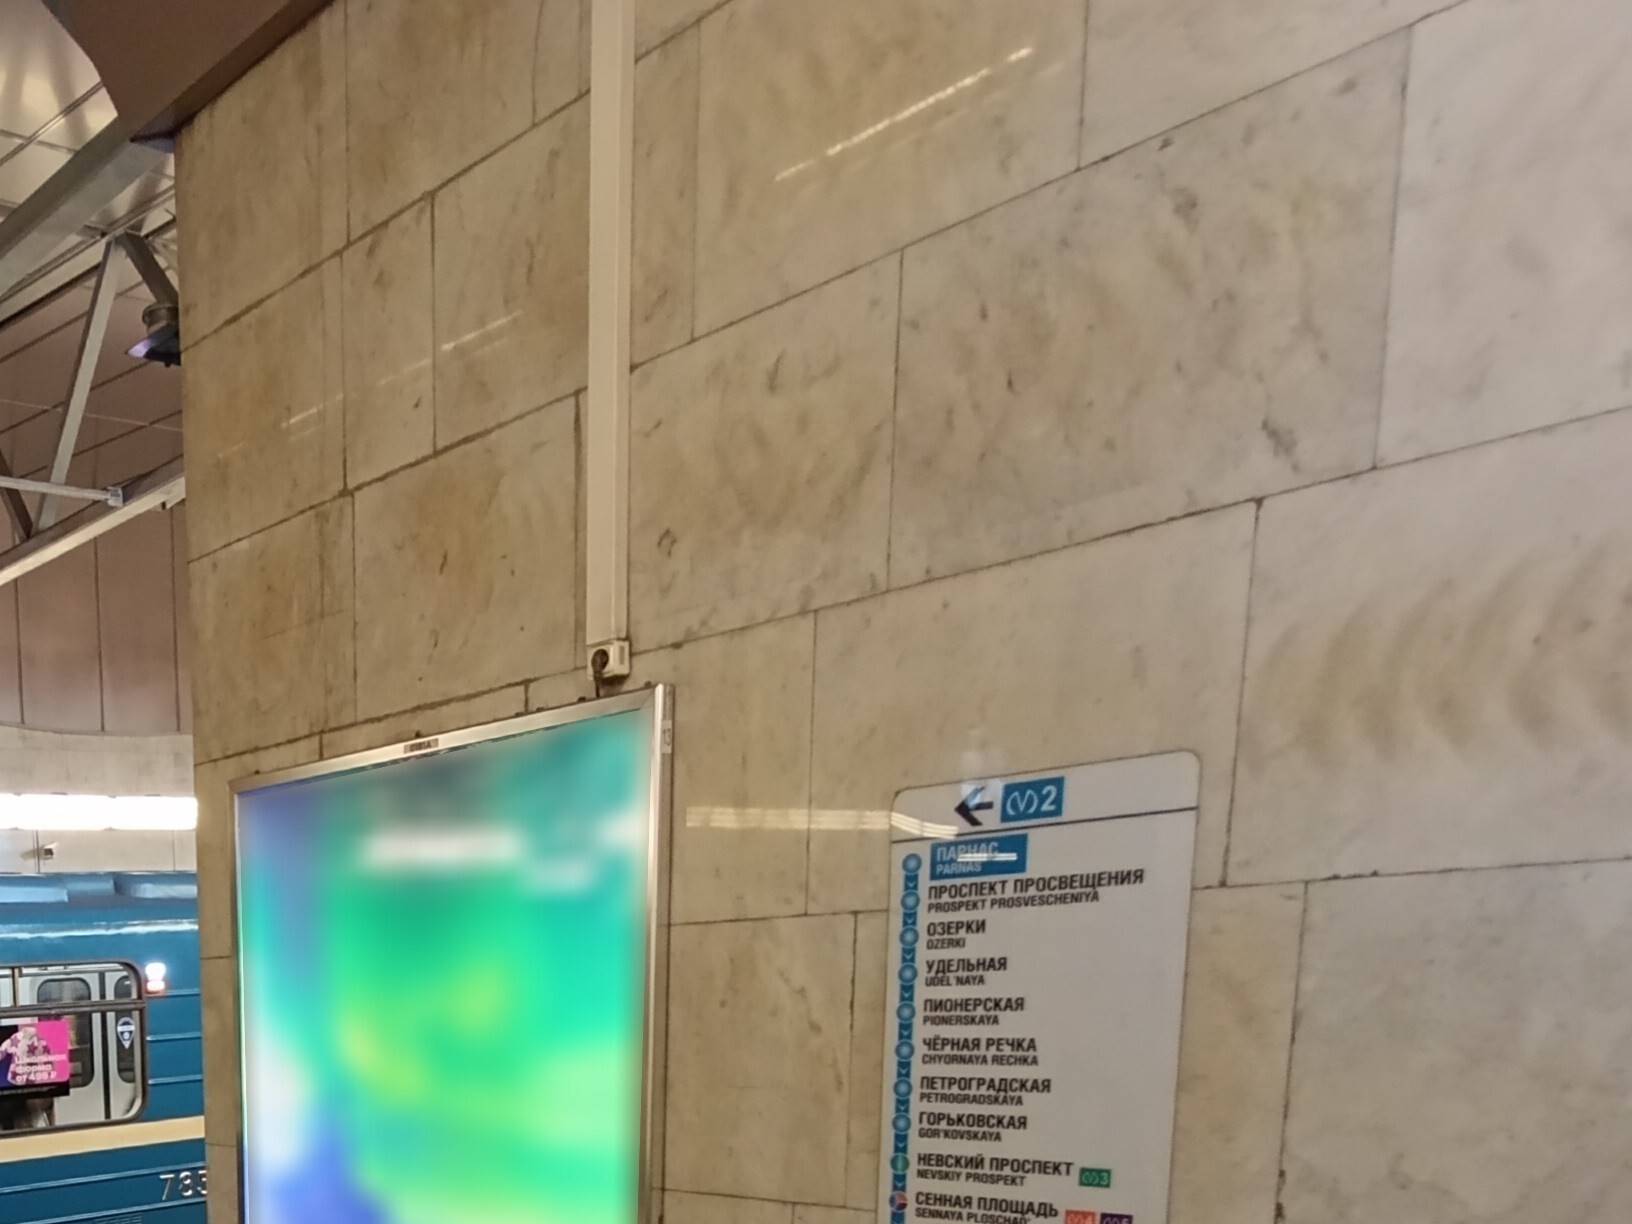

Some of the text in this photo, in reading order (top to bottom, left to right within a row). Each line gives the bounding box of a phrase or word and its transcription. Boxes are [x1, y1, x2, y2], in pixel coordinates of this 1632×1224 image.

[937, 842, 999, 861] ПАРНАС
[936, 862, 982, 875] PARNAS
[928, 868, 1144, 900] ПРОСПЕКТ ПРОСВЕЩЕНИЯ
[927, 891, 1100, 914] PROSPEKT PROSVESCHENIYA
[927, 919, 986, 937] ОЗЕРКИ
[926, 938, 966, 950] OZERKI
[925, 957, 1008, 975] УДЕЛЬНАЯ
[925, 974, 985, 987] UDEL'NAYA
[923, 998, 1025, 1013] ПИОНЕРСКАЯ
[922, 1014, 999, 1026] PIONERSKAYA
[922, 1034, 1037, 1052] ЧЁРНАЯ РЕЧКА
[921, 1054, 1038, 1067] CHYORNAYA RECHKA
[920, 1076, 1051, 1094] ПЕТРОГРАДСКАЯ
[919, 1093, 1023, 1107] PETROGRADSKAYA
[918, 1112, 1027, 1130] ГОРЬКОВСКАЯ
[918, 1128, 1002, 1142] GOR'KOVSKAYA
[917, 1152, 1074, 1177] НЕВСКИЙ ПРОСПЕКТ
[916, 1169, 1026, 1187] NEVSKIY PROSPEKT
[915, 1191, 1059, 1219] СЕННАЯ ПЛОЩАДЬ
[915, 1207, 963, 1222] SENNAYA
